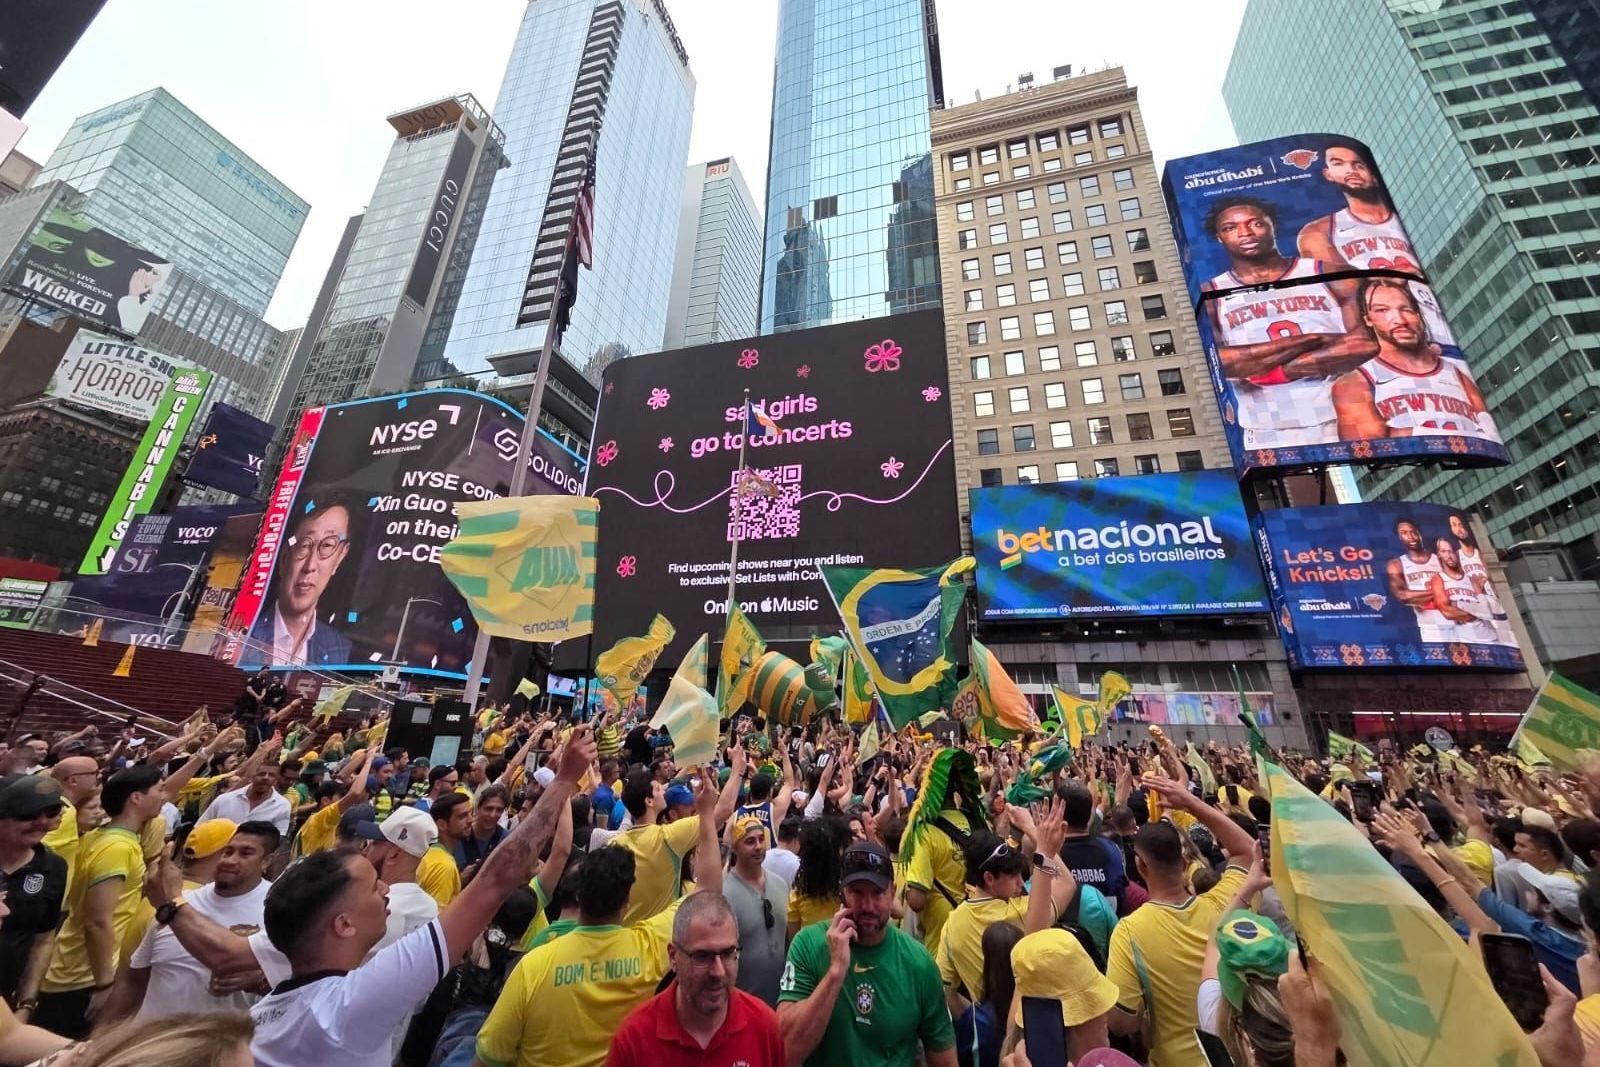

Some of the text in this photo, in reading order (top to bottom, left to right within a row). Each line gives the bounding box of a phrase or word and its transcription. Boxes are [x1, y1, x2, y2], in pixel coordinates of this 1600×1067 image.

[708, 164, 730, 176] RIU
[1185, 177, 1216, 189] abu
[426, 179, 459, 253] GUCCI
[1341, 236, 1378, 262] NEW
[1225, 303, 1268, 331] NEW
[1269, 296, 1331, 315] YORK
[83, 342, 177, 379] LITTLE SHO
[69, 357, 165, 407] HORROR
[769, 394, 818, 421] girls
[1376, 393, 1426, 421] NEW
[690, 419, 852, 458] go to concerts
[111, 396, 188, 541] CANNABIS
[402, 471, 503, 500] NYSE con
[373, 496, 400, 512] Xin
[404, 494, 447, 512] Guo
[386, 521, 410, 535] on
[377, 543, 441, 564] Co-CE
[668, 563, 688, 573] Find
[737, 559, 769, 570] shows
[770, 559, 792, 569] near
[794, 557, 813, 570] you
[814, 555, 834, 566] and
[835, 554, 864, 565] listen
[1058, 545, 1226, 567] a bet dos brasileiros
[1284, 546, 1373, 565] Let's Go
[680, 576, 690, 586] to
[735, 573, 751, 584] Set
[753, 571, 777, 583] Lists
[778, 570, 799, 582] with
[801, 569, 823, 580] Con
[1290, 564, 1374, 582] Knicks!!
[704, 596, 819, 615] Onl on Music
[1300, 601, 1351, 611] abu dhabi
[866, 624, 902, 639] ORDEM
[905, 622, 913, 630] E
[554, 957, 641, 987] BOM E NOVO
